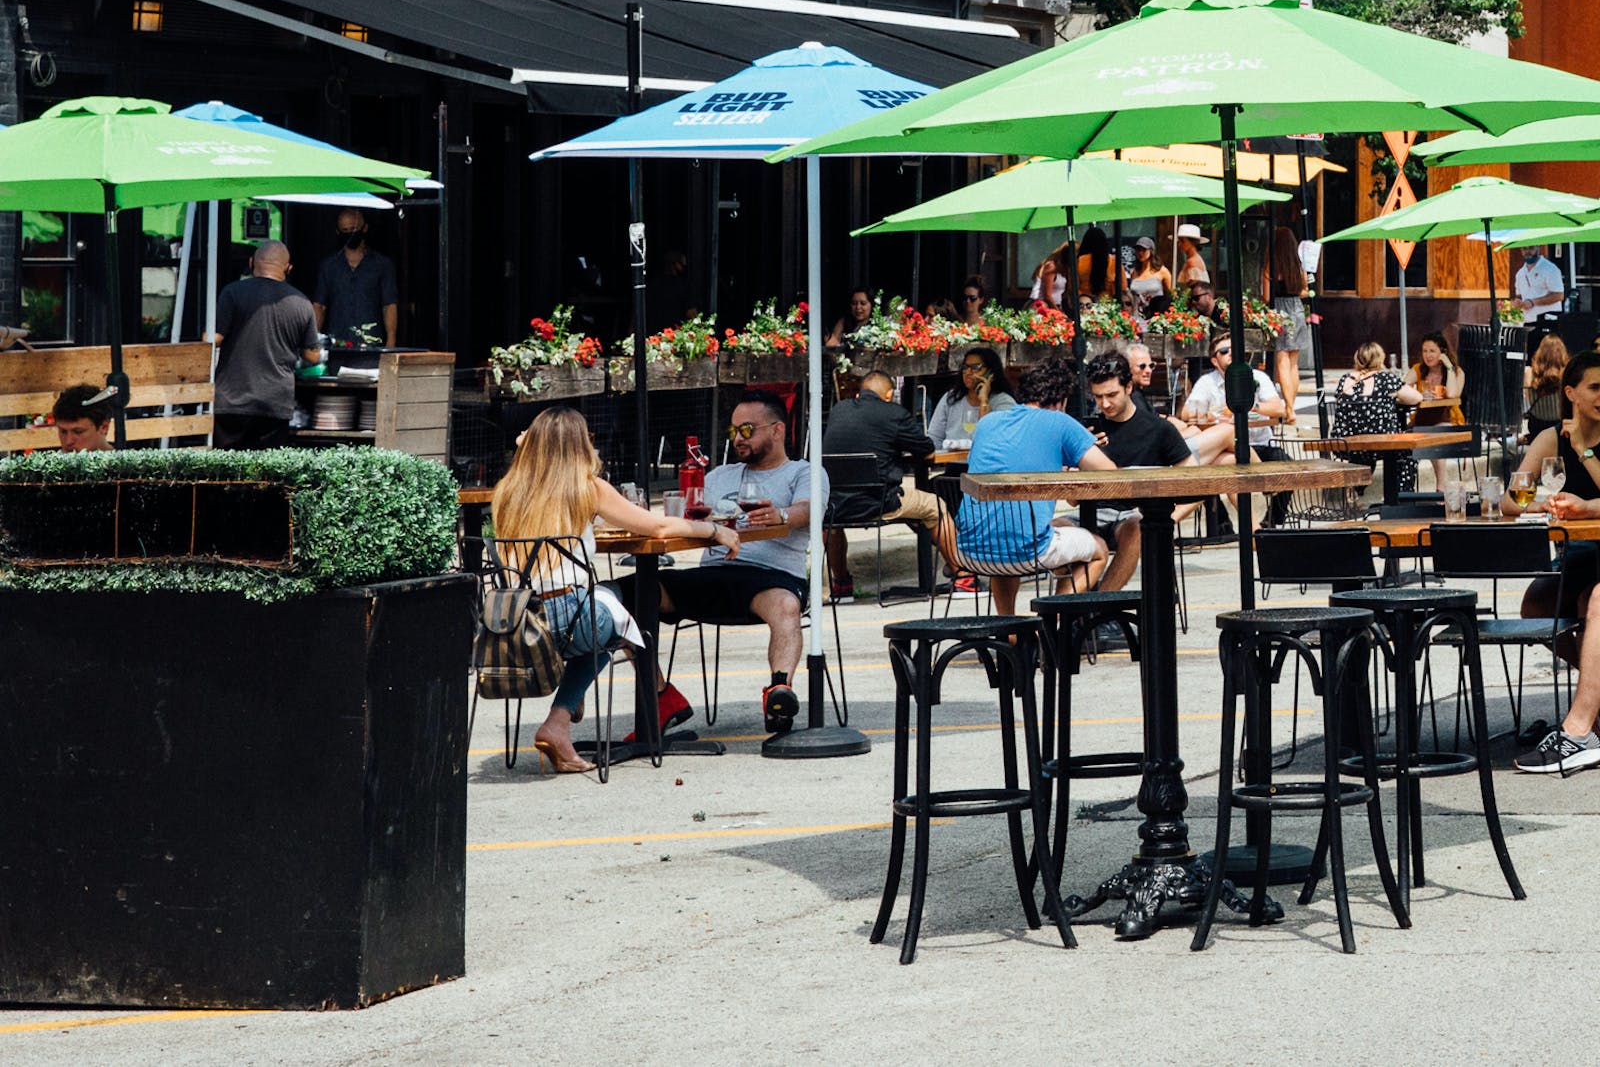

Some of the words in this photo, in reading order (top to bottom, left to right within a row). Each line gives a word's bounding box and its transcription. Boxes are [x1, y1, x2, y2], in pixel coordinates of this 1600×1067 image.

[704, 91, 788, 103] BUD
[678, 100, 794, 113] LIGHT
[673, 112, 774, 126] SELTZER
